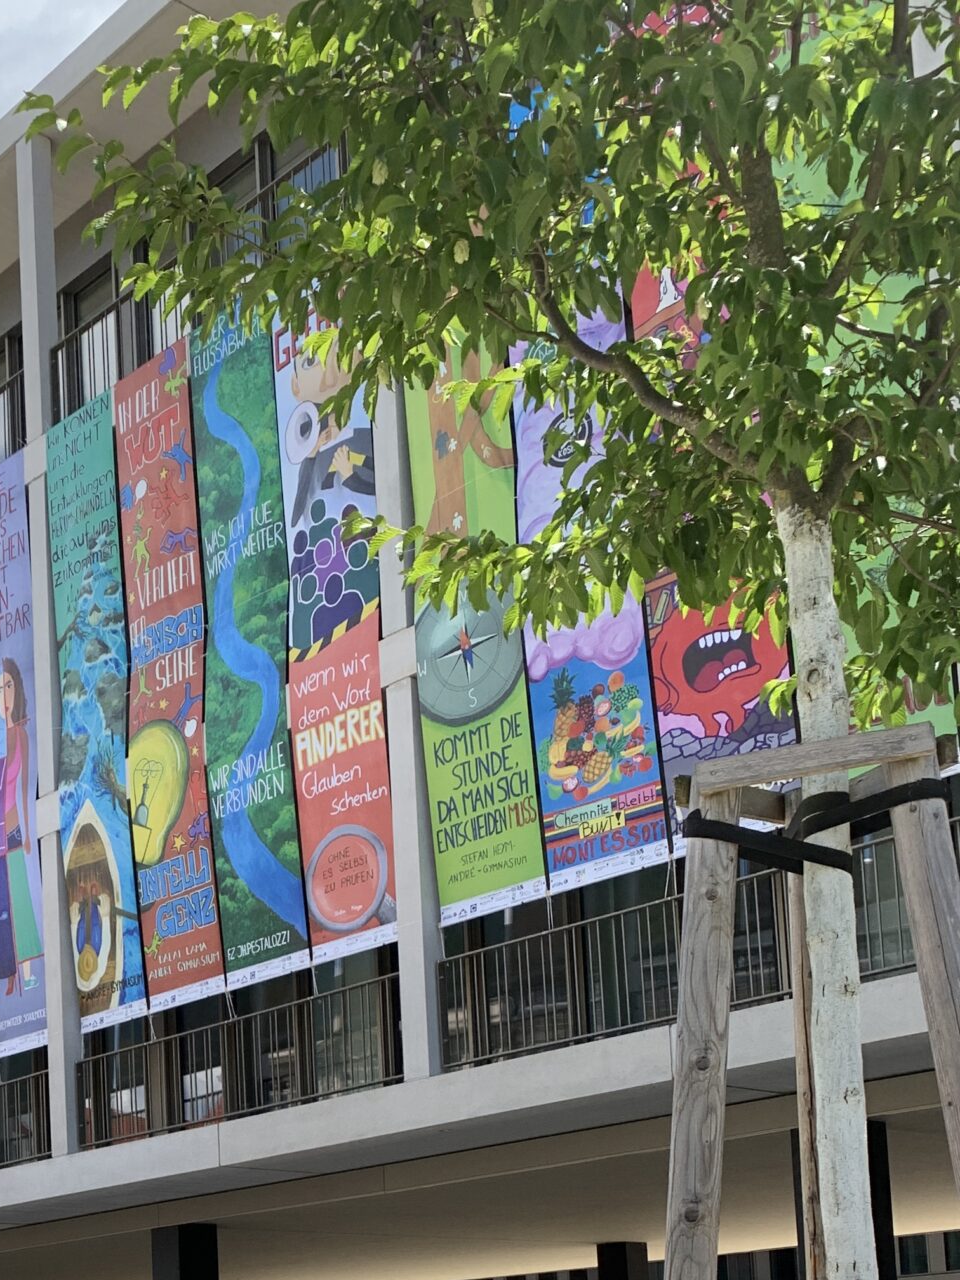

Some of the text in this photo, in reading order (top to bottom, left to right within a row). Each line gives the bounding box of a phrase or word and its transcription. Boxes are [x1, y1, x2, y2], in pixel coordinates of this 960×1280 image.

[118, 379, 160, 434] IN DER
[66, 421, 102, 461] NICHT
[124, 402, 180, 475] WUT
[70, 461, 85, 480] die
[69, 521, 91, 551] auf
[204, 500, 273, 557] WAS ICH TUE
[206, 521, 284, 580] WIRKT WEITER
[137, 550, 197, 610] VERLIERT
[130, 603, 204, 674] MENSCH
[155, 643, 198, 692] SEINE
[342, 652, 370, 678] wir
[417, 660, 427, 677] W
[298, 678, 371, 730] dem Wort
[468, 687, 477, 708] S
[295, 700, 385, 772] ANDERER
[432, 711, 523, 769] KOMMT DIE
[210, 741, 285, 794] WIR SIND ALLE
[301, 764, 362, 799] Glauben
[451, 744, 520, 791] STUNDE,
[212, 771, 285, 820] VERBUNDEN
[436, 770, 529, 825] DA MAN SICH
[554, 788, 656, 828] Chemnitz bleibt
[436, 795, 538, 854] ENTSCHEIDEN MUSS
[138, 846, 212, 906] INTELLI
[322, 854, 368, 880] ES SELBST
[328, 846, 350, 864] OHNE
[460, 848, 489, 866] STEFAN
[324, 882, 336, 894] ZU
[155, 885, 218, 941] GENZ
[177, 951, 220, 972] GYMNASIUM
[186, 942, 208, 956] LAMA
